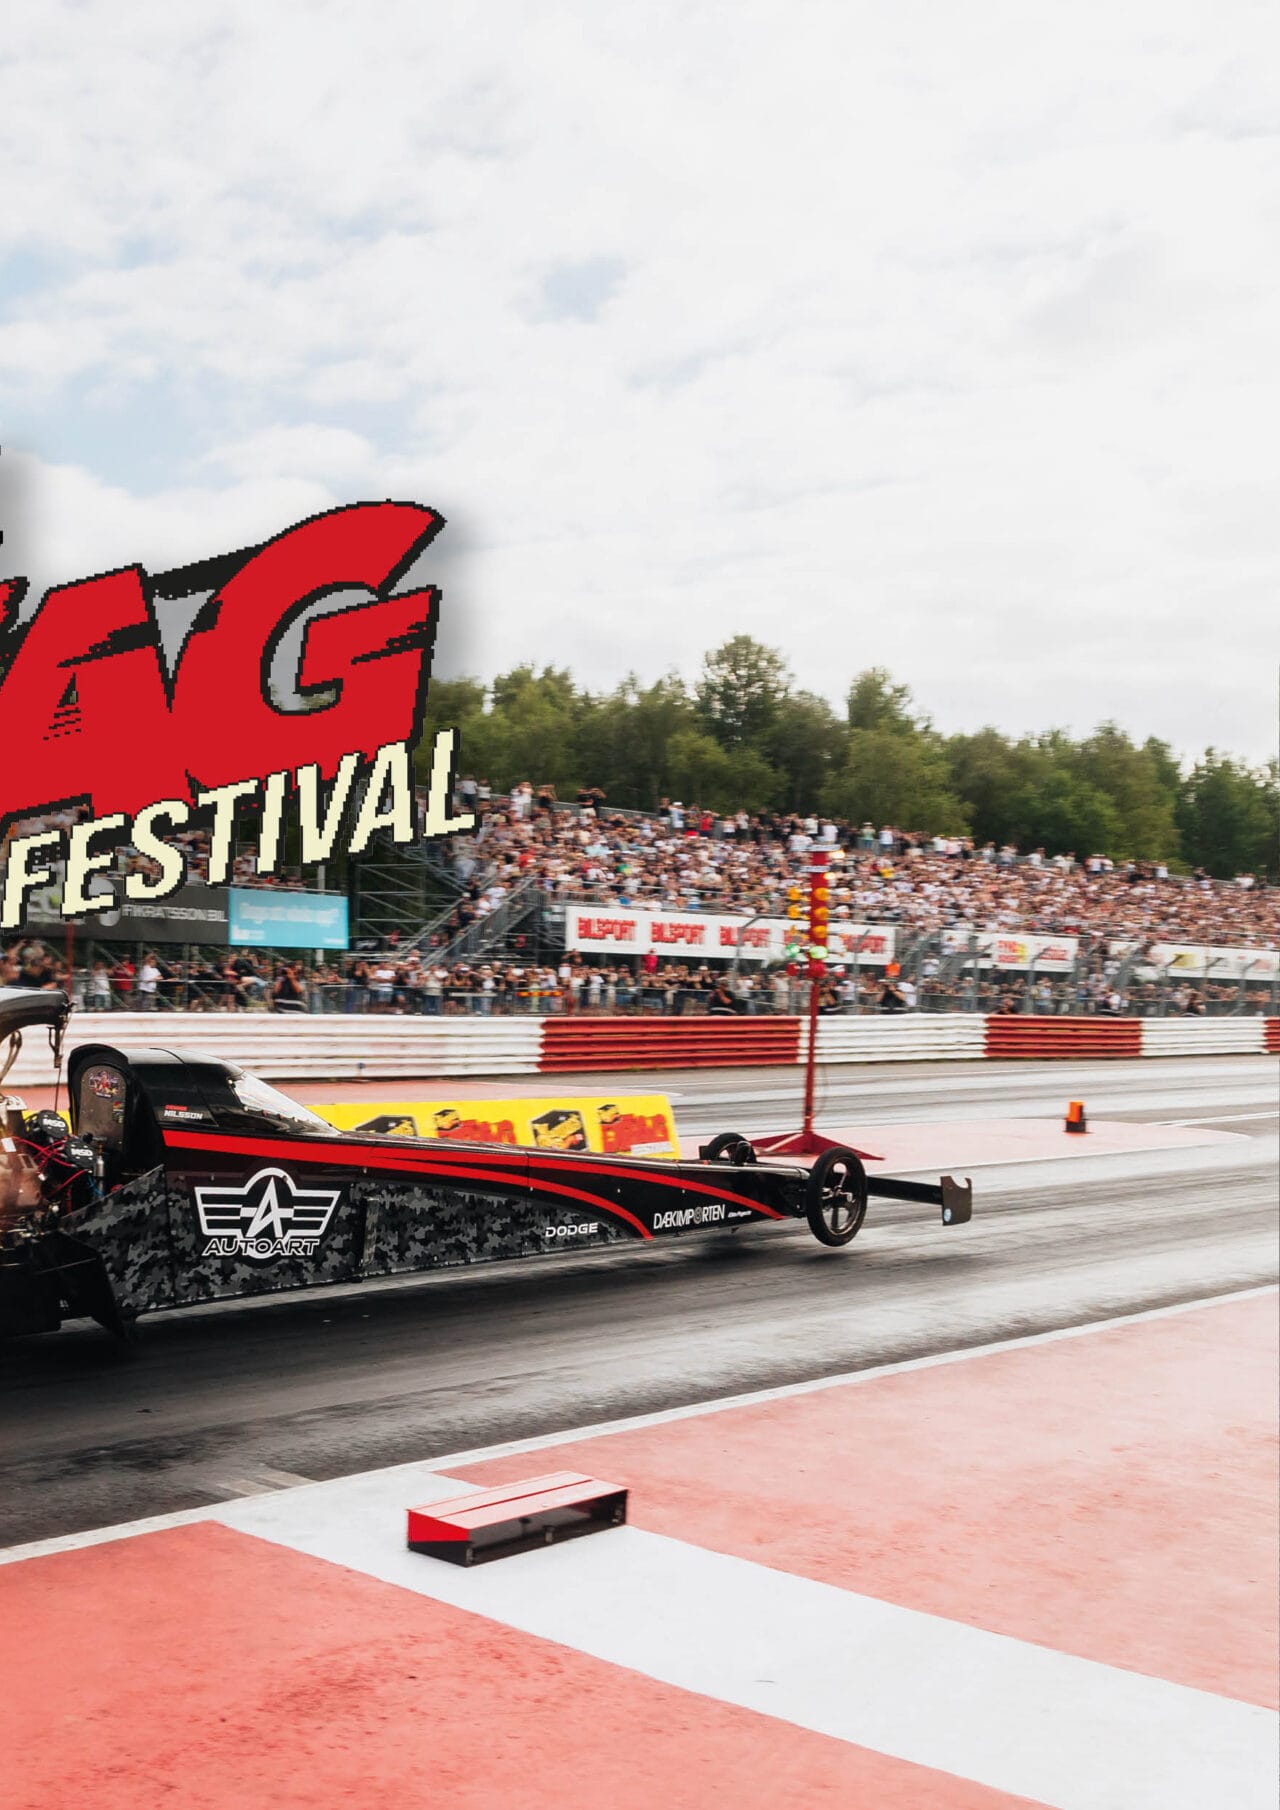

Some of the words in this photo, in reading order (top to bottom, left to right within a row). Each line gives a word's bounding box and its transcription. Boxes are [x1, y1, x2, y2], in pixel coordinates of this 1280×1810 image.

[164, 1110, 203, 1119] NILSSON
[545, 1223, 598, 1237] DODGE
[202, 1238, 320, 1256] AUTOART
